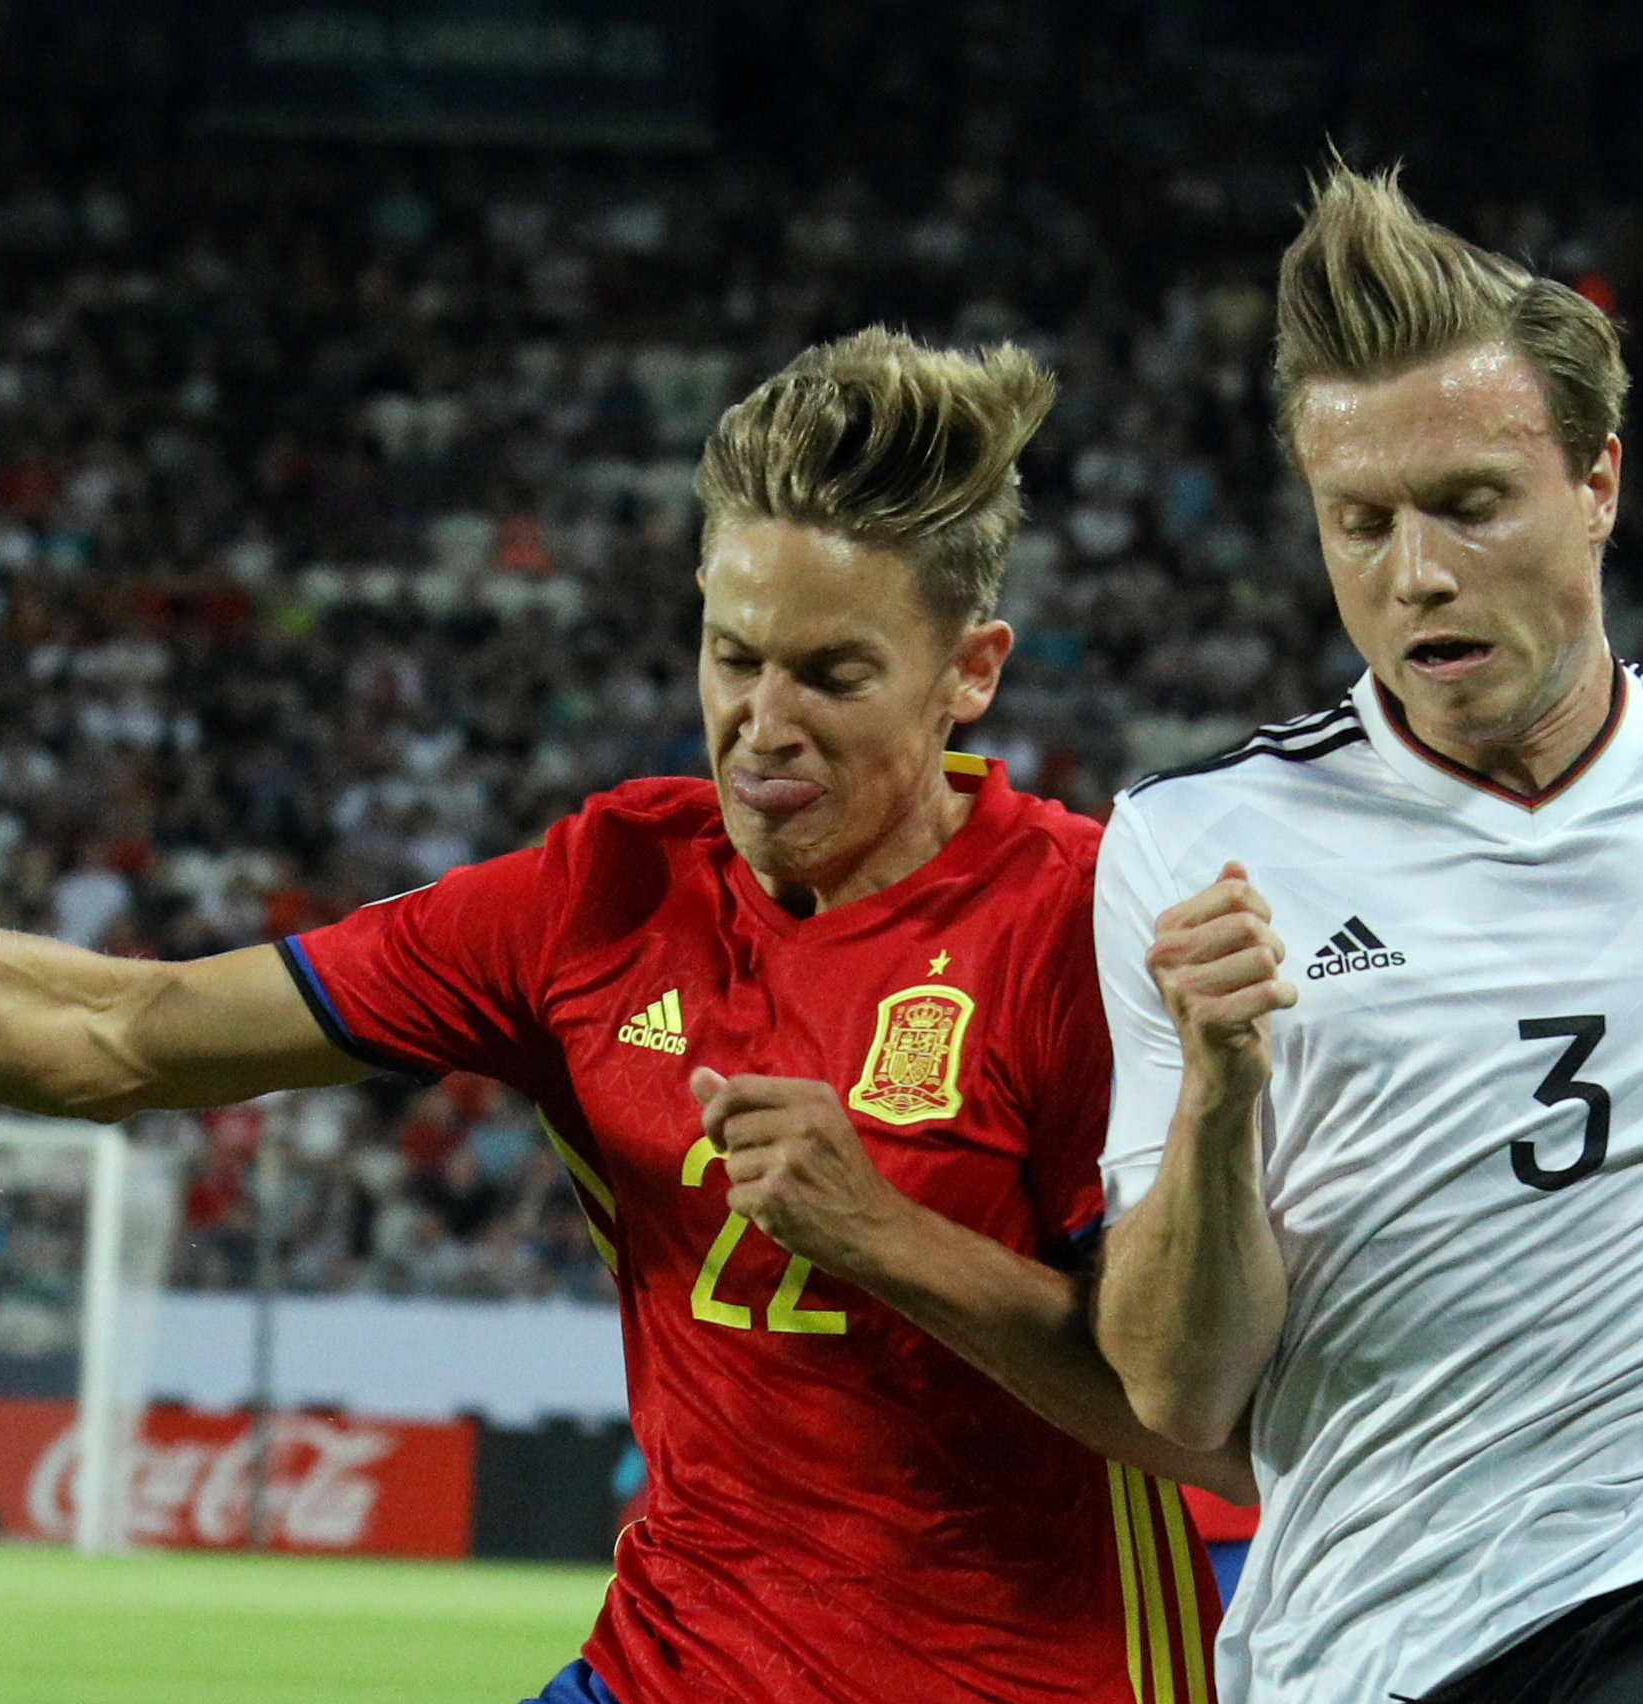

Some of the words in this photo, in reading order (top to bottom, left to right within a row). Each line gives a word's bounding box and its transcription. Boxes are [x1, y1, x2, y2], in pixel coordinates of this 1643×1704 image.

[1306, 947, 1406, 980] adidas
[618, 1023, 687, 1056] adidas
[1509, 1014, 1611, 1192] 3
